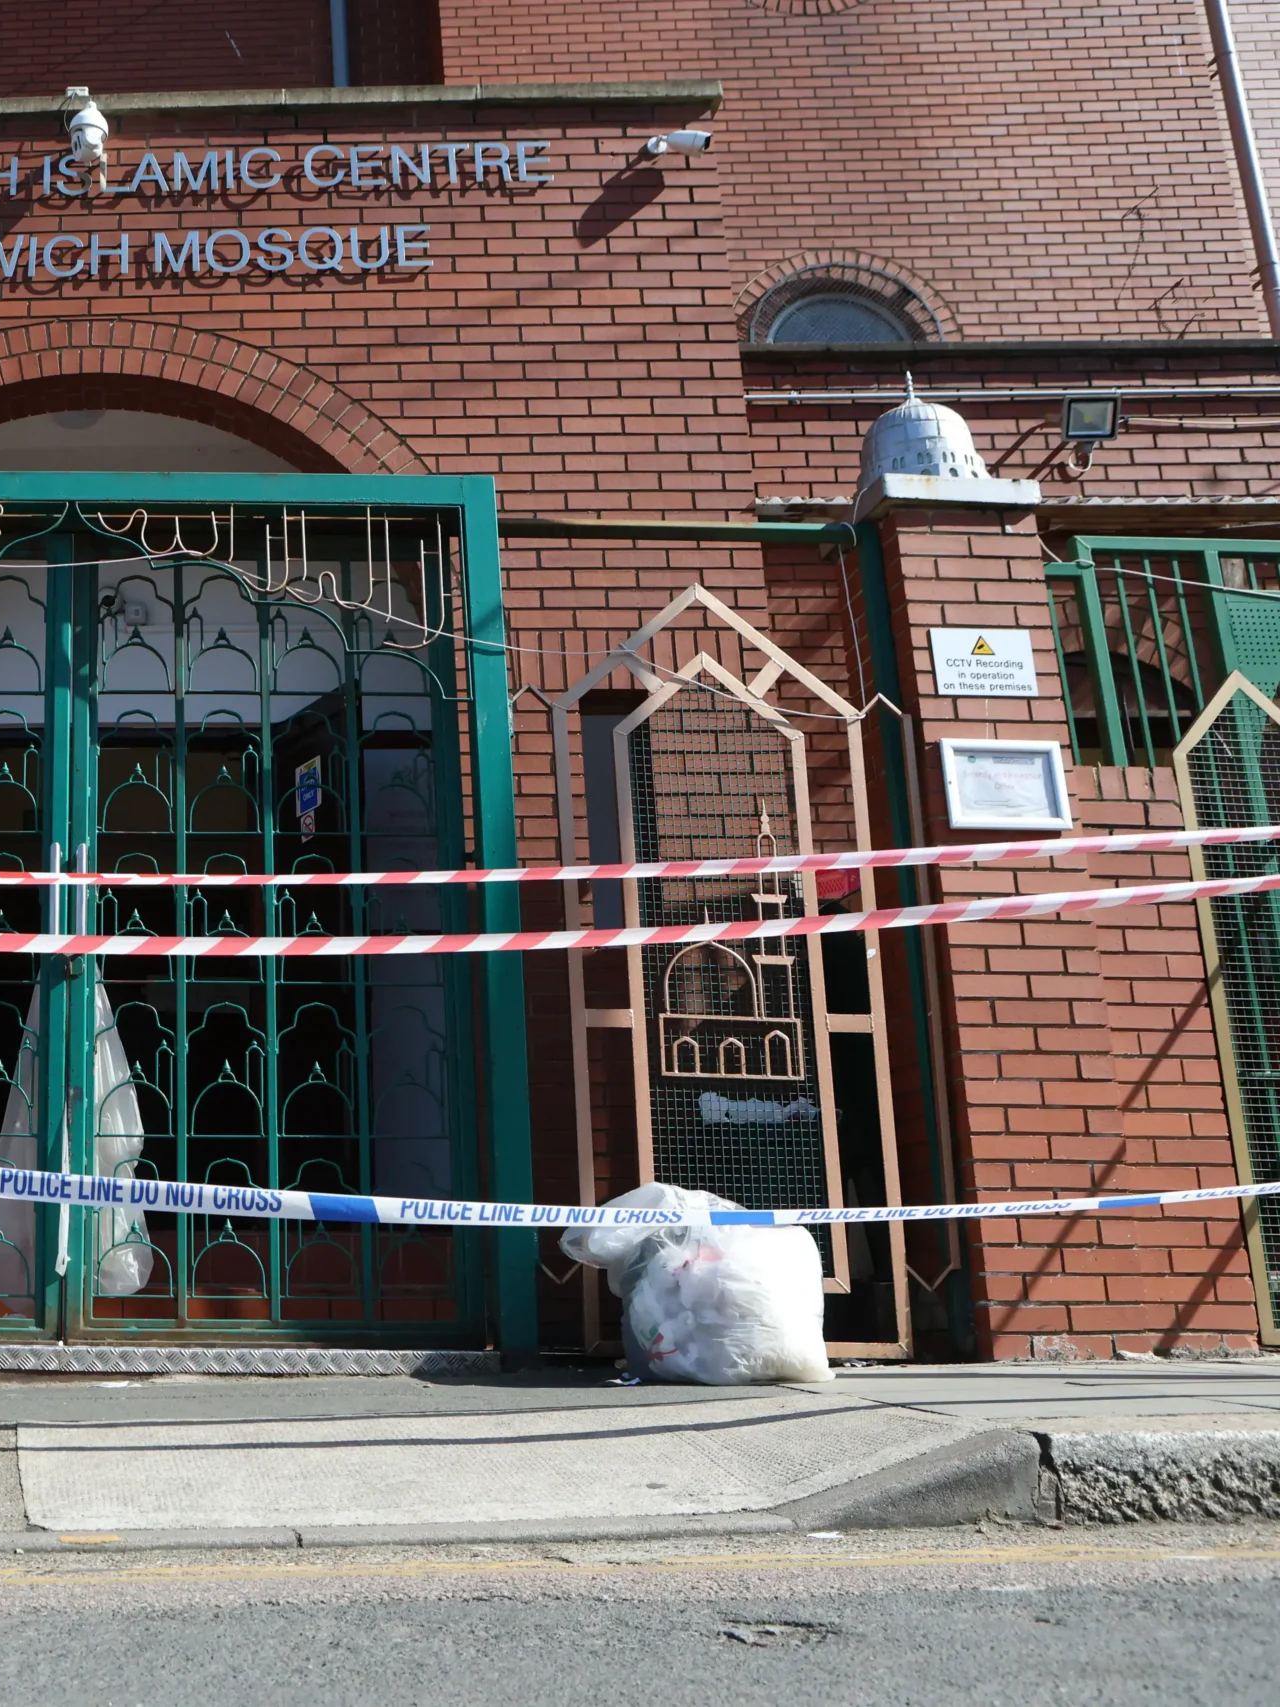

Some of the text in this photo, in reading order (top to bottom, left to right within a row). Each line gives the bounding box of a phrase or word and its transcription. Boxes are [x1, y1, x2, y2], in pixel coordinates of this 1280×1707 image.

[43, 147, 281, 197] ISLAMIC
[303, 141, 555, 189] CENTRE
[154, 224, 434, 273] MOSQUE
[946, 658, 1023, 670] CCTV Recording
[958, 670, 1015, 681] in operation
[943, 682, 1033, 692] on these premises
[0, 1168, 282, 1213] POLICE LINE DO NOT CROSS
[400, 1200, 686, 1224] POLICE LINE DO NOT CROSS
